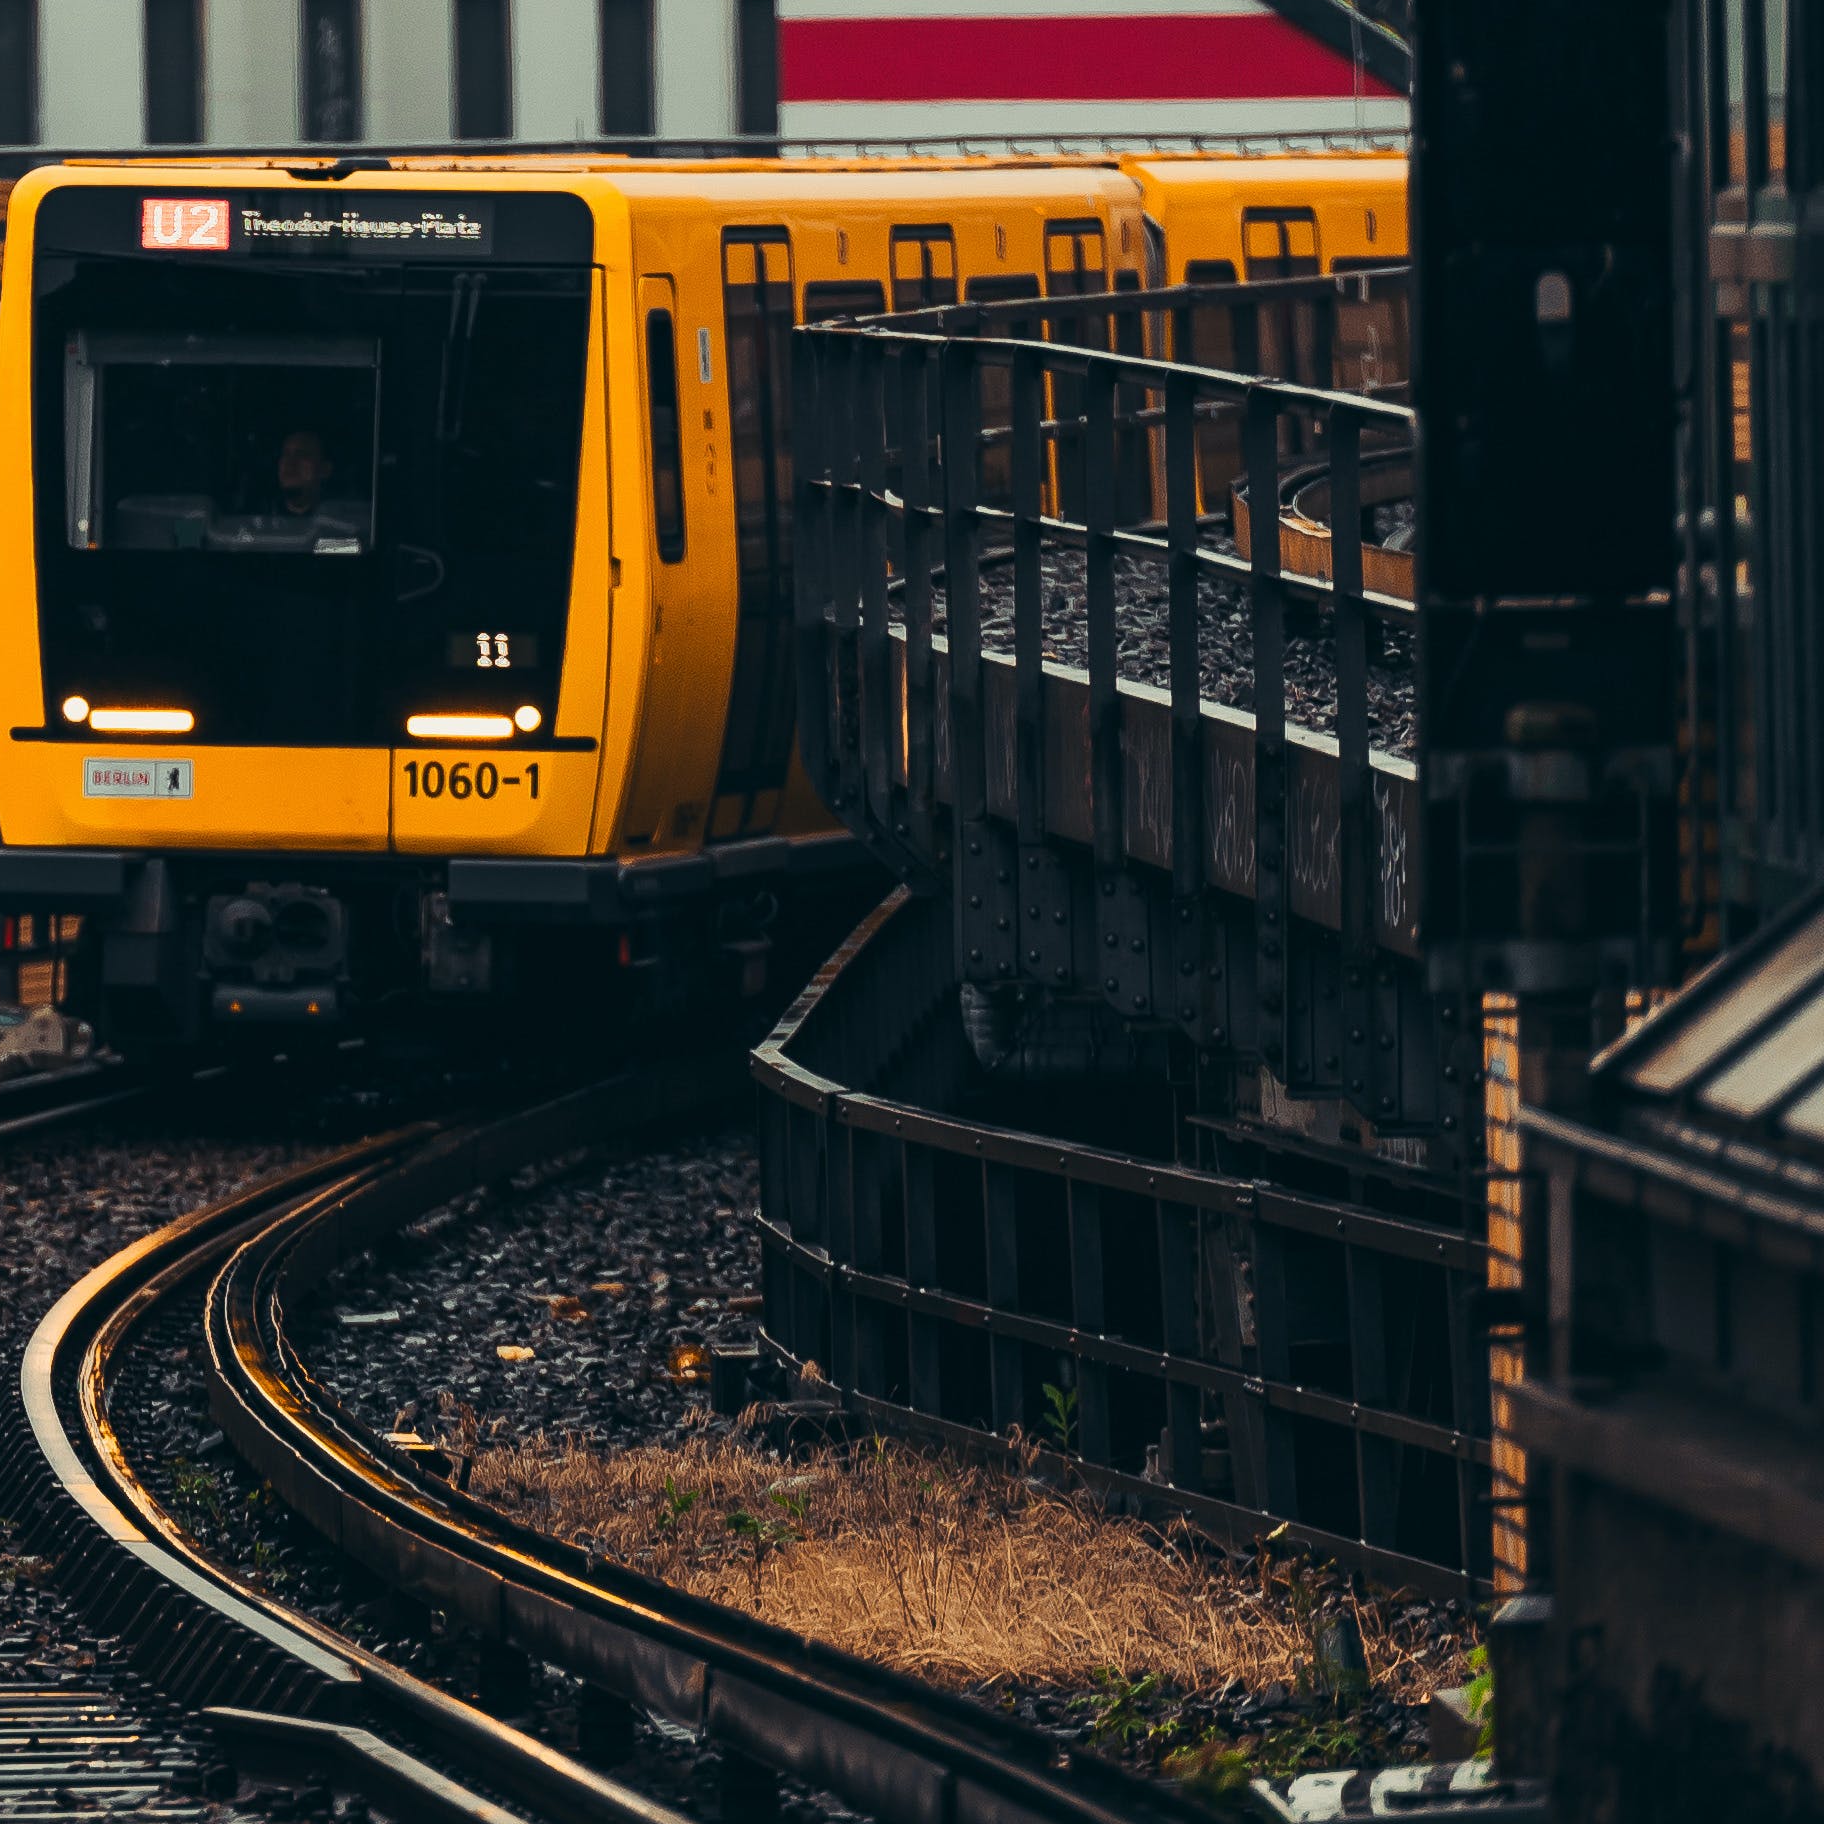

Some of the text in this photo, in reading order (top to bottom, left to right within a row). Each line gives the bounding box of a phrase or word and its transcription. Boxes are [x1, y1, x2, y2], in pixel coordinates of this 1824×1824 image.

[153, 205, 218, 244] U2
[93, 770, 150, 785] BERLIN
[403, 761, 539, 799] 1060-1
